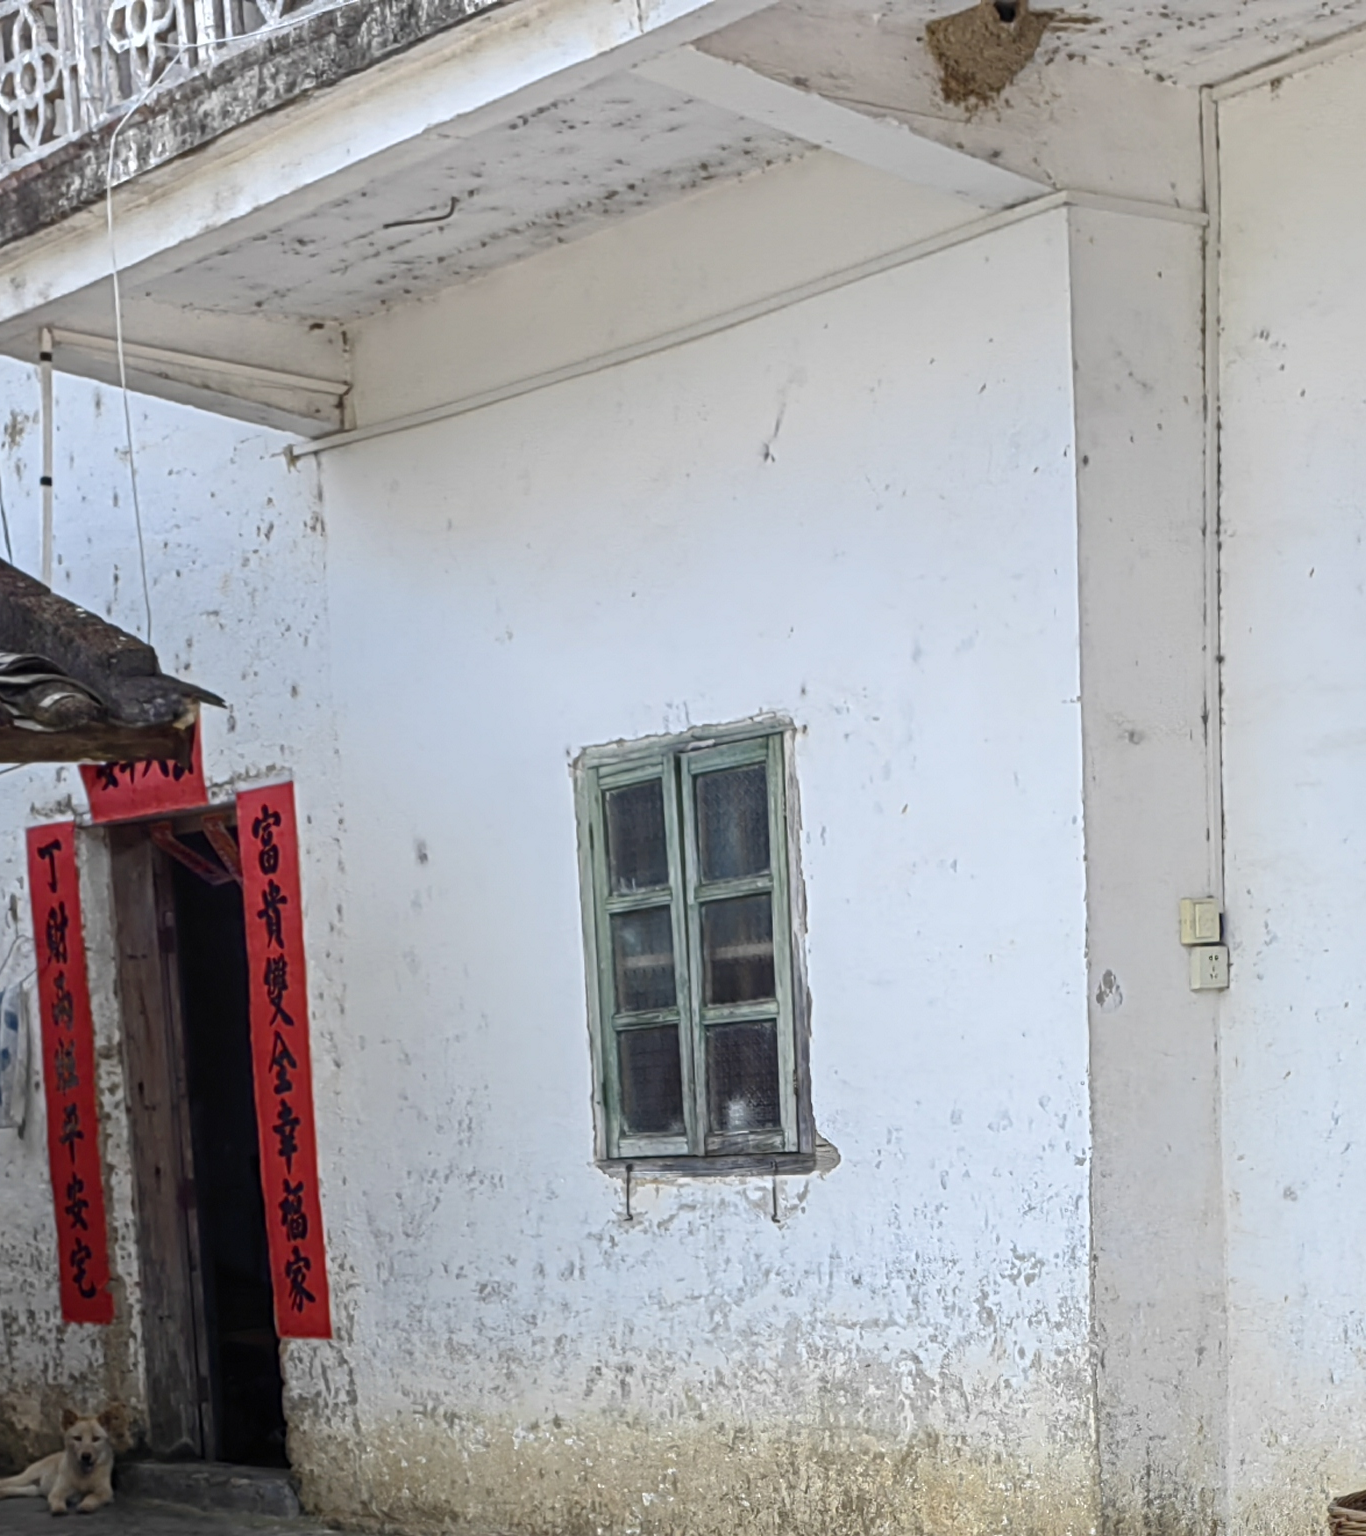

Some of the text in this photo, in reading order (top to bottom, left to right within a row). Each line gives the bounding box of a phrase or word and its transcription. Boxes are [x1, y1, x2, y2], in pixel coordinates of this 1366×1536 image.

[252, 804, 316, 1313] 富貴雙全幸福家
